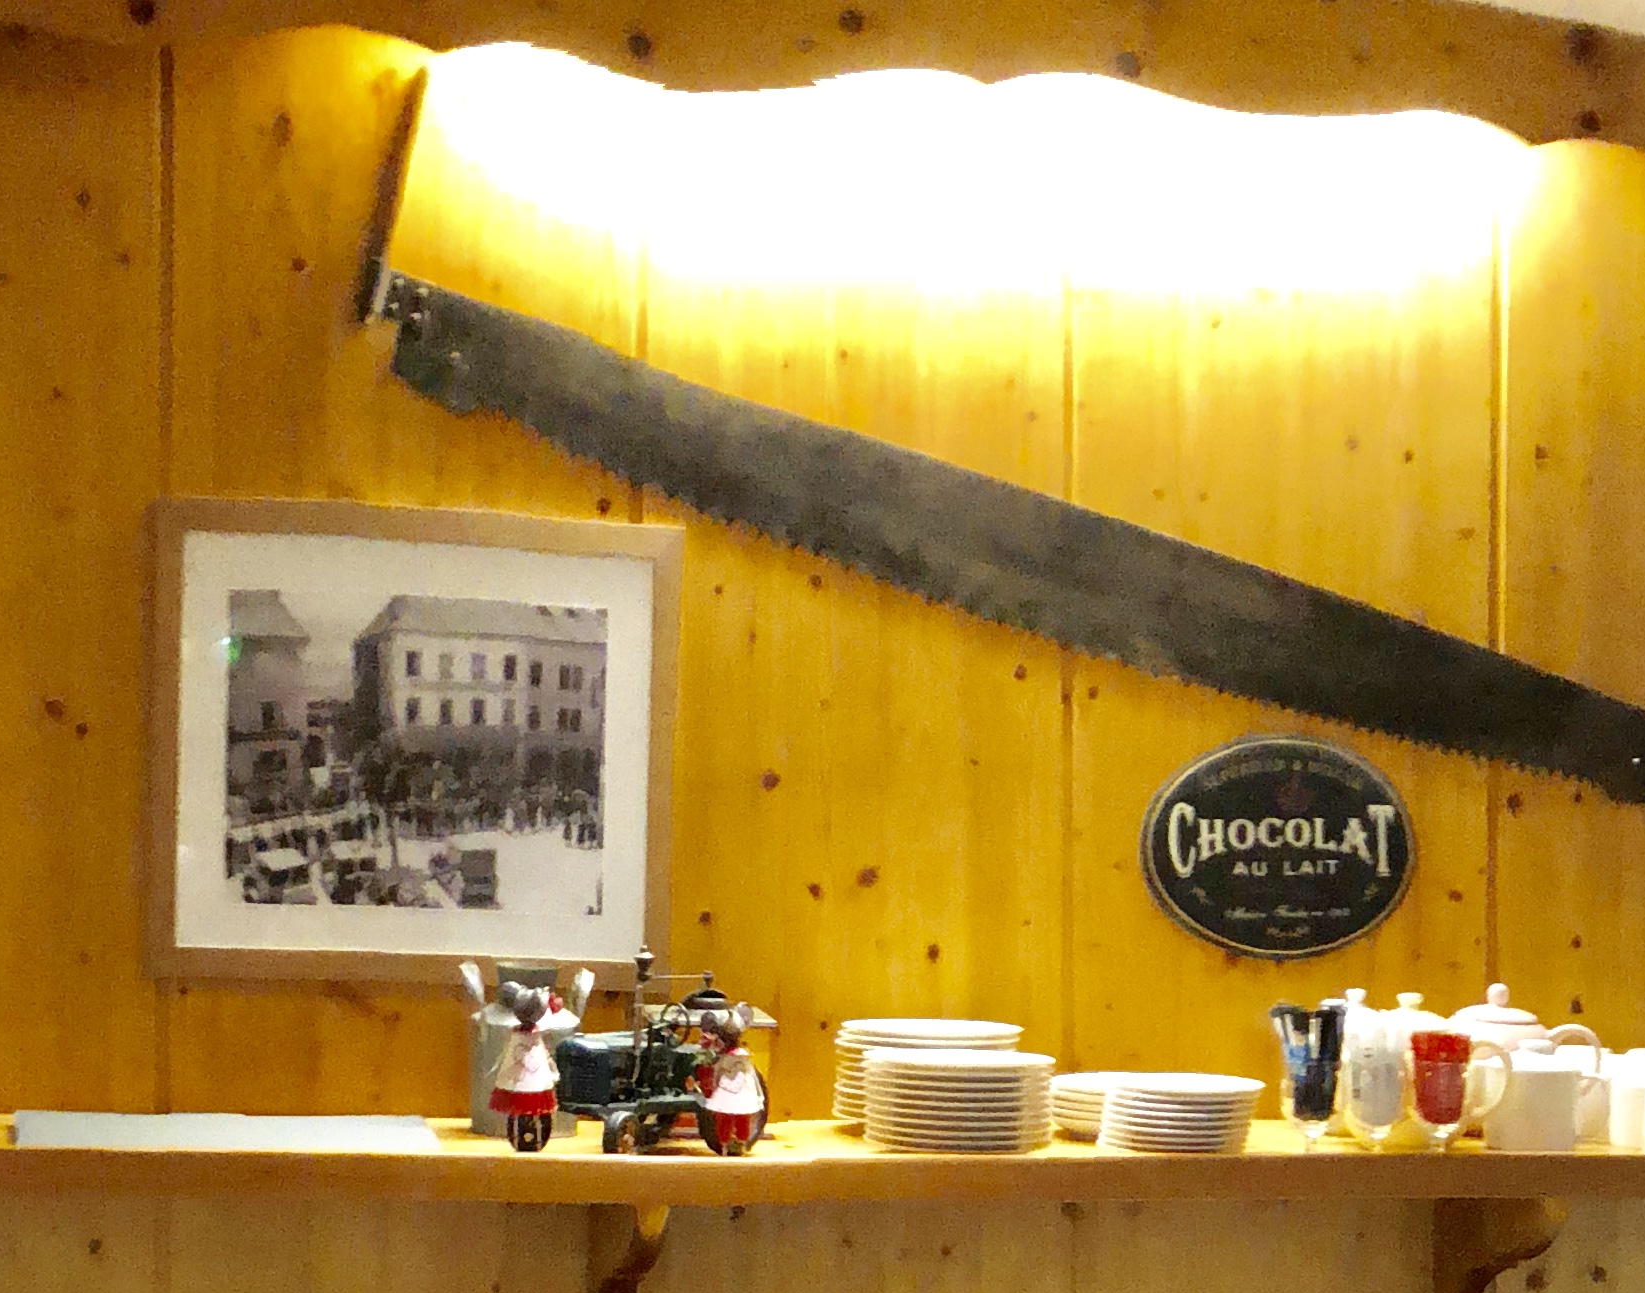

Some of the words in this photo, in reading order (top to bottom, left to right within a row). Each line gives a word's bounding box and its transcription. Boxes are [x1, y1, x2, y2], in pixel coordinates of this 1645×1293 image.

[1168, 803, 1396, 878] CHOCOLAT
[1232, 859, 1268, 877] AU
[1282, 859, 1340, 877] LAIT
